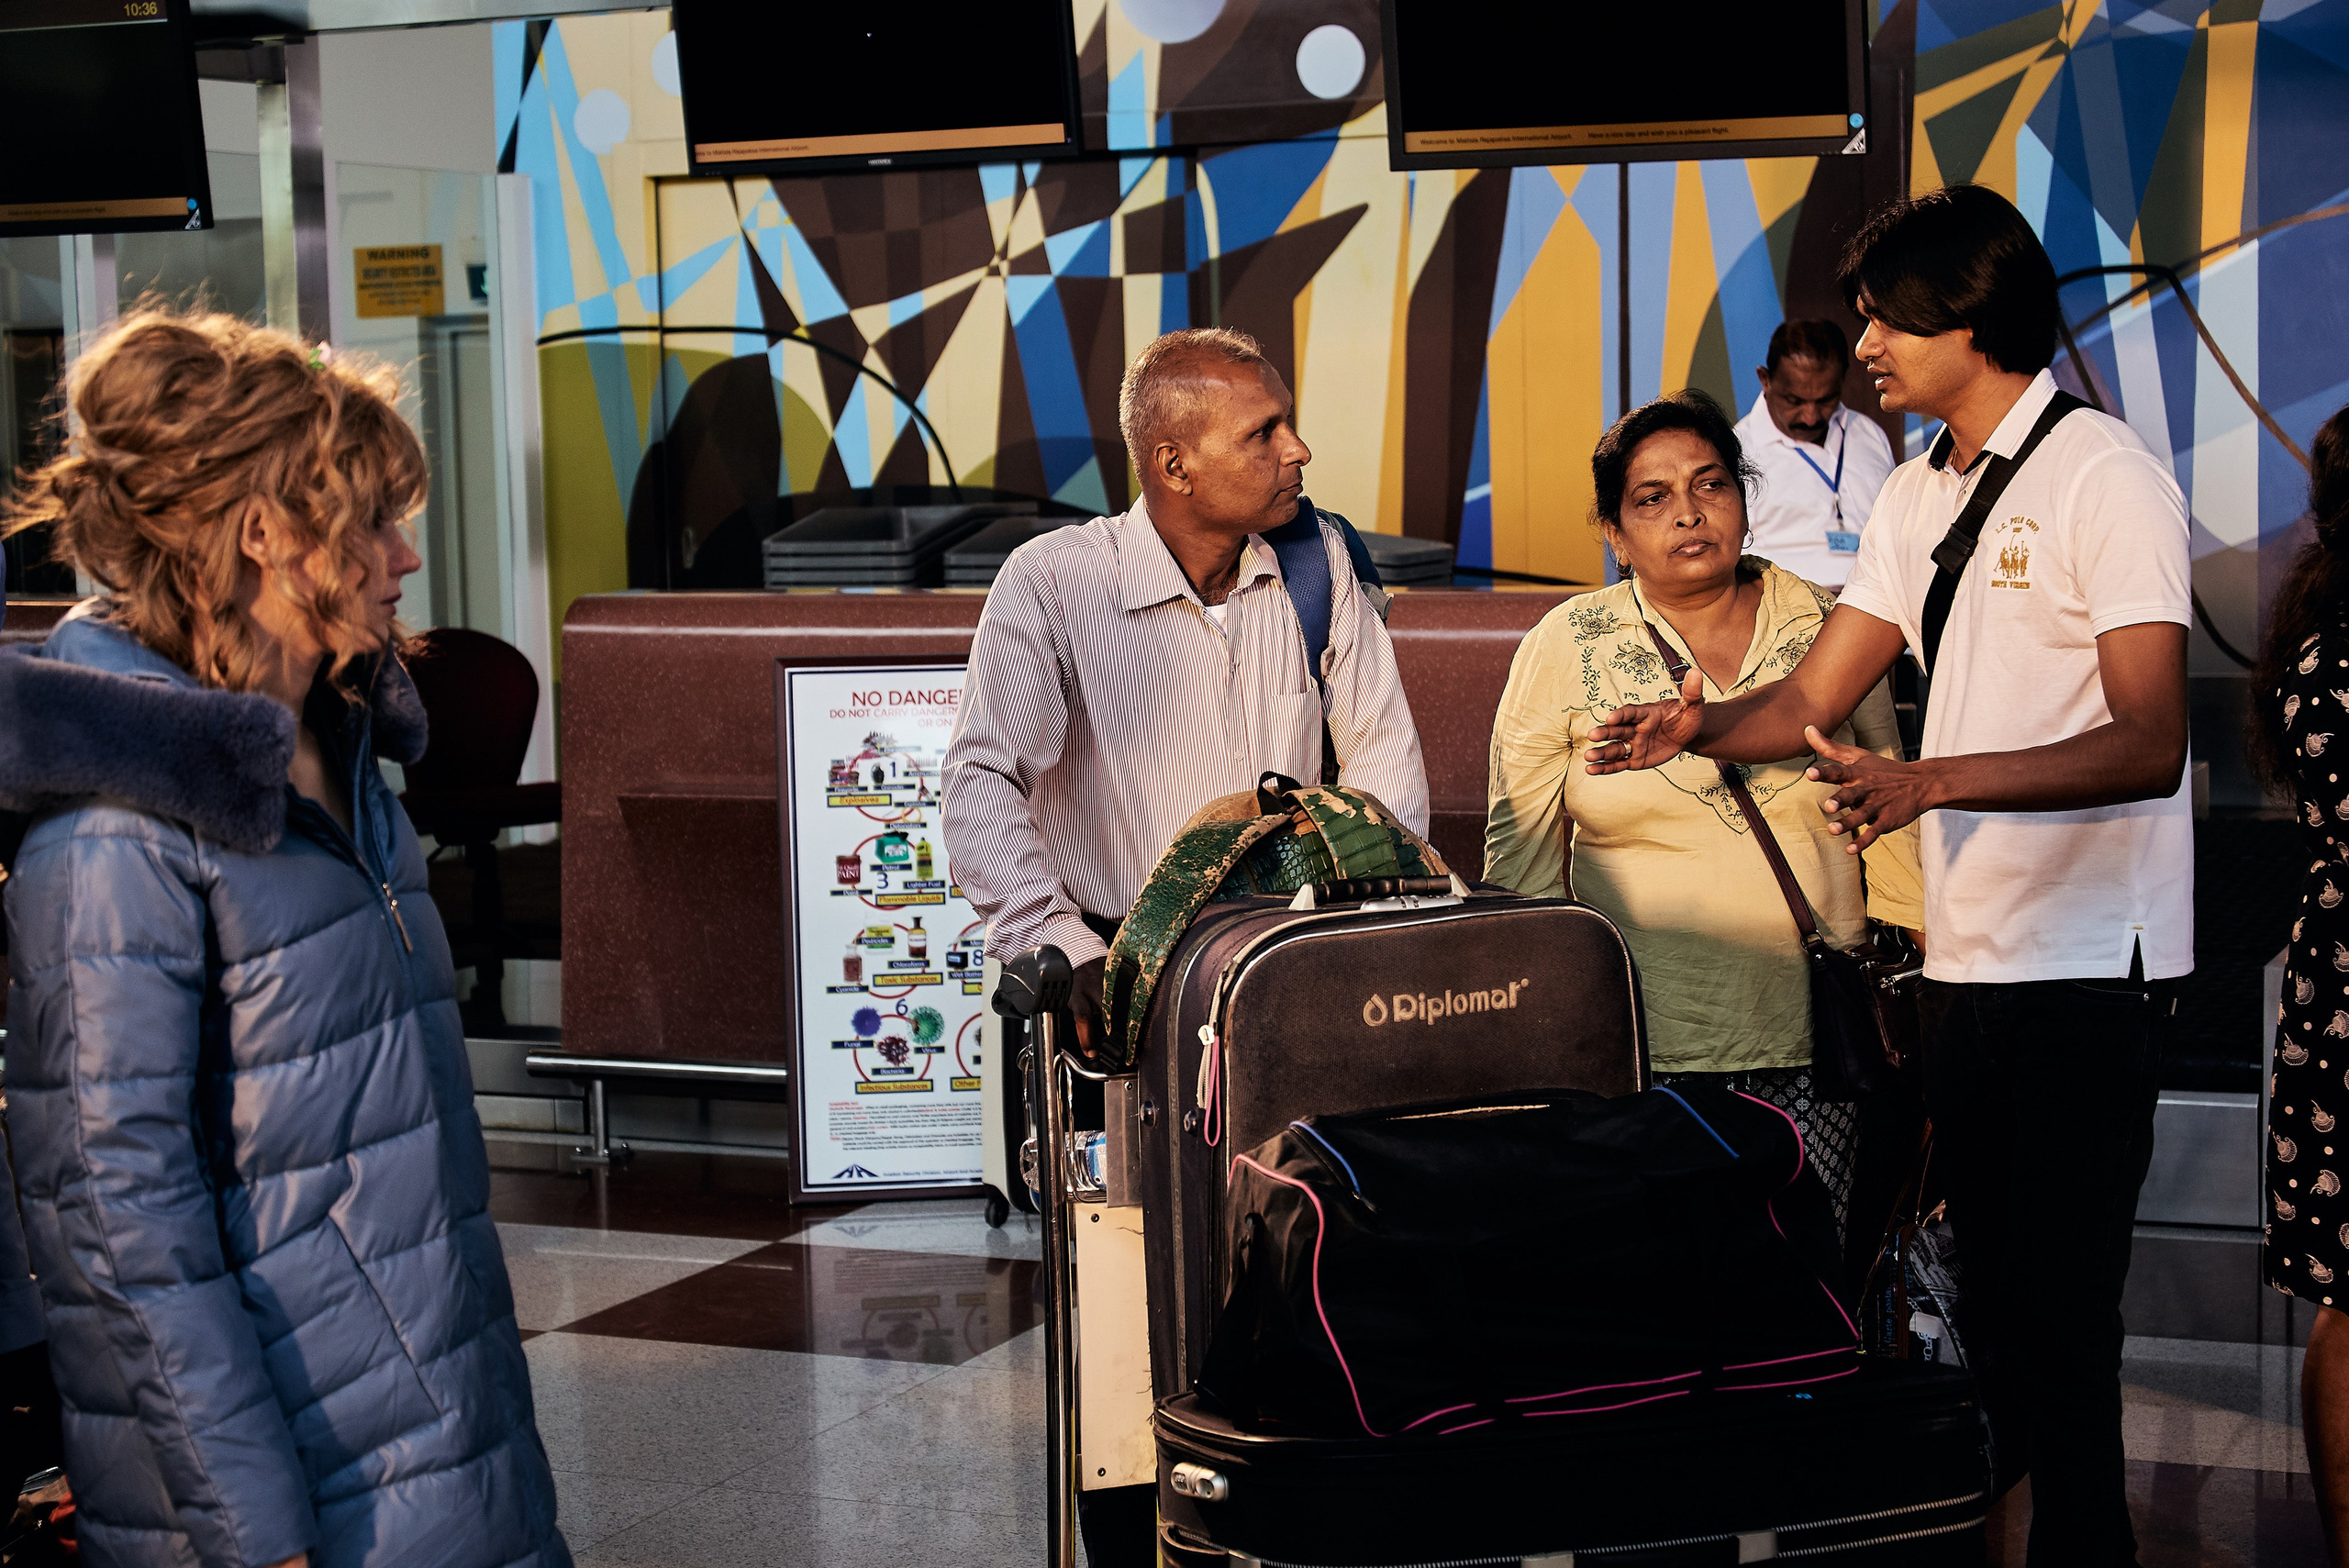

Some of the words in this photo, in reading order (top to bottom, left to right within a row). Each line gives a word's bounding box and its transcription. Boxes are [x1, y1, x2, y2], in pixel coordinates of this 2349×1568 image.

[124, 2, 158, 17] 10:36
[367, 246, 430, 261] WARNING
[852, 691, 883, 706] NO
[829, 709, 846, 718] DO
[848, 708, 871, 718] NOT
[874, 707, 908, 718] CARRY
[917, 718, 932, 728] OR
[935, 717, 952, 728] ON
[889, 761, 896, 778] 1
[839, 795, 880, 806] Explosives
[876, 872, 889, 890] 3
[878, 896, 917, 905] Flammable
[918, 895, 941, 904] Liquids
[861, 937, 889, 945] Pesticides
[973, 949, 984, 967] 8
[880, 974, 897, 984] Toxic
[898, 974, 938, 984] Substances
[896, 998, 908, 1016] 6
[860, 1083, 892, 1091] Infectious
[892, 1082, 929, 1091] Substances
[954, 1080, 975, 1088] Other
